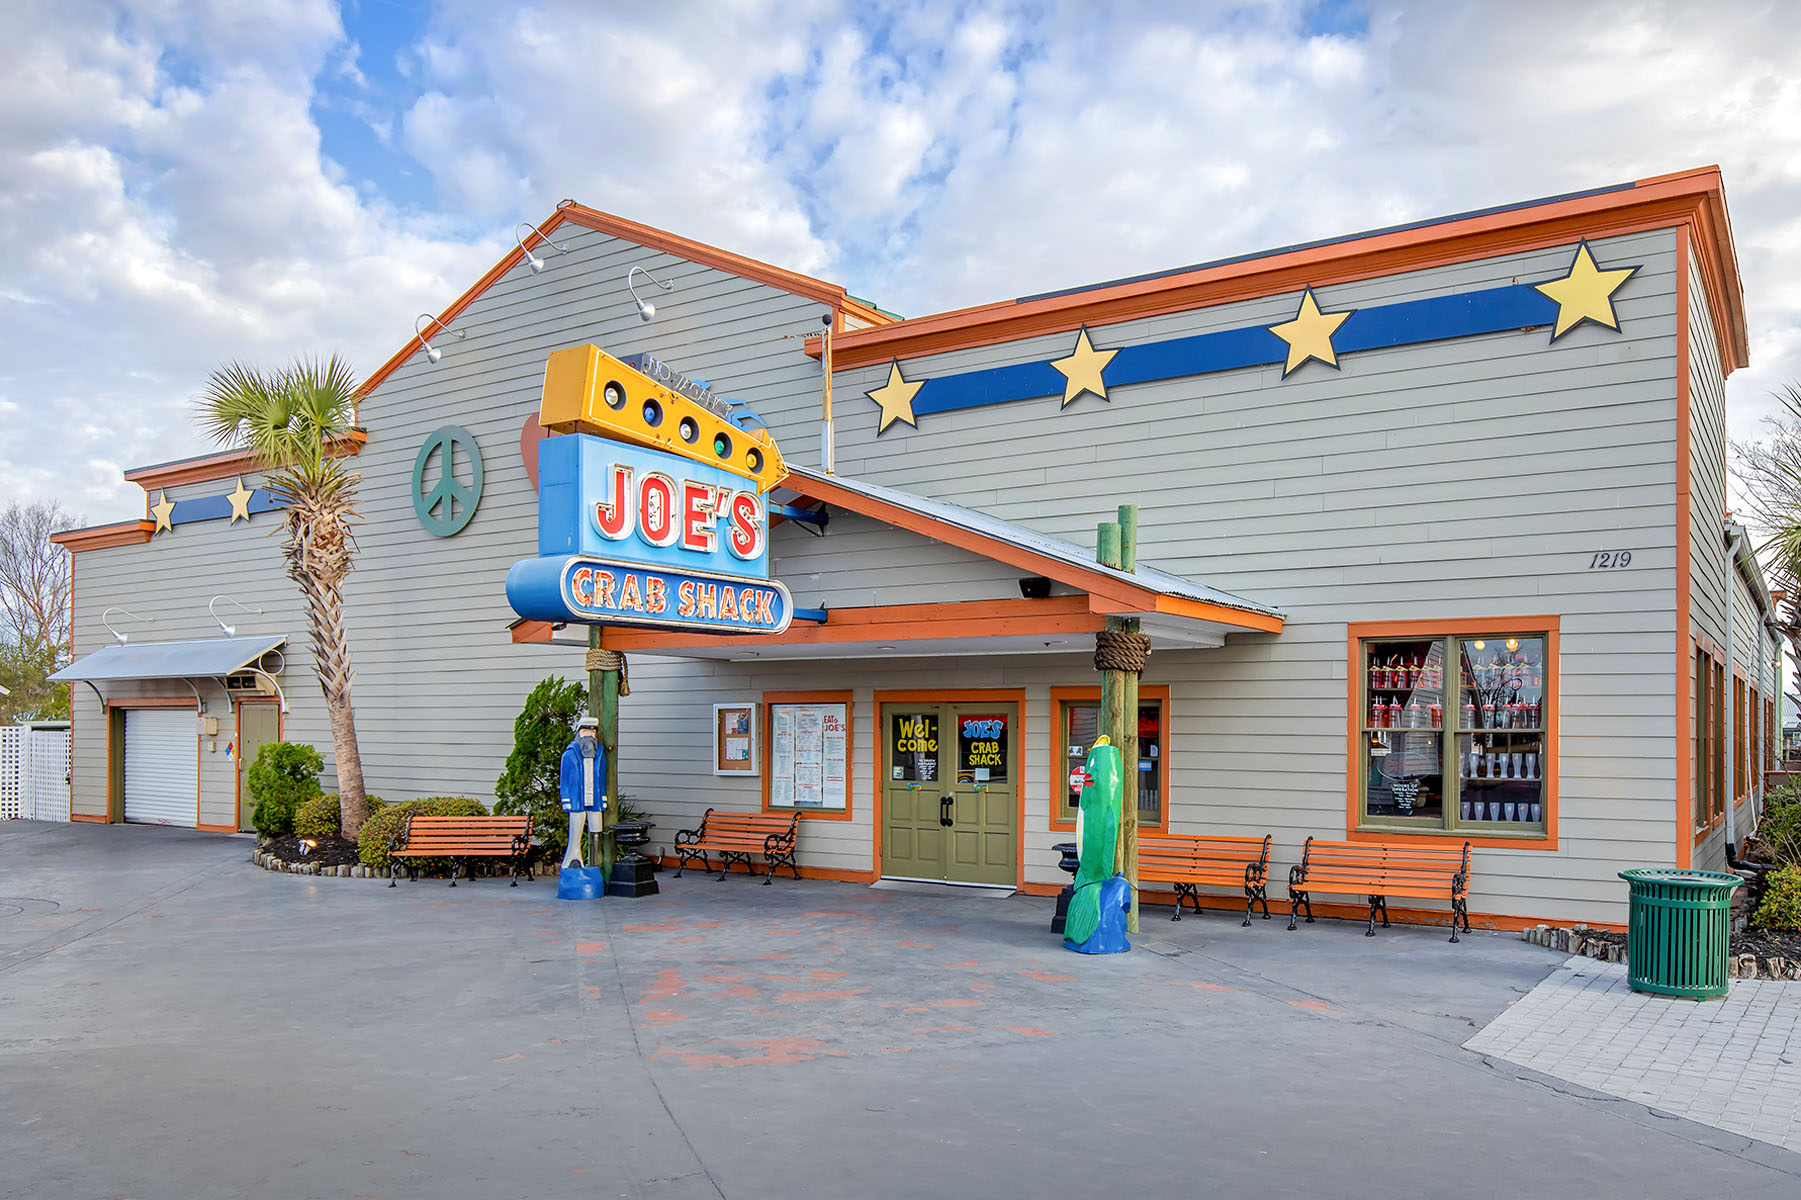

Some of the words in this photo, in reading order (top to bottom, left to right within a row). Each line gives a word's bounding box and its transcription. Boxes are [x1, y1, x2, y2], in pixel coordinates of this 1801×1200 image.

[646, 356, 671, 380] NO
[590, 463, 766, 560] JOE'S
[1589, 551, 1632, 569] 1219
[571, 567, 668, 613] CRAB
[678, 580, 778, 624] SHACK
[824, 723, 846, 732] JOE'S
[899, 718, 938, 738] Wel-
[963, 719, 1004, 739] JOE'S
[897, 739, 938, 752] come
[971, 742, 999, 754] CRAB
[969, 754, 1002, 766] SHACK
